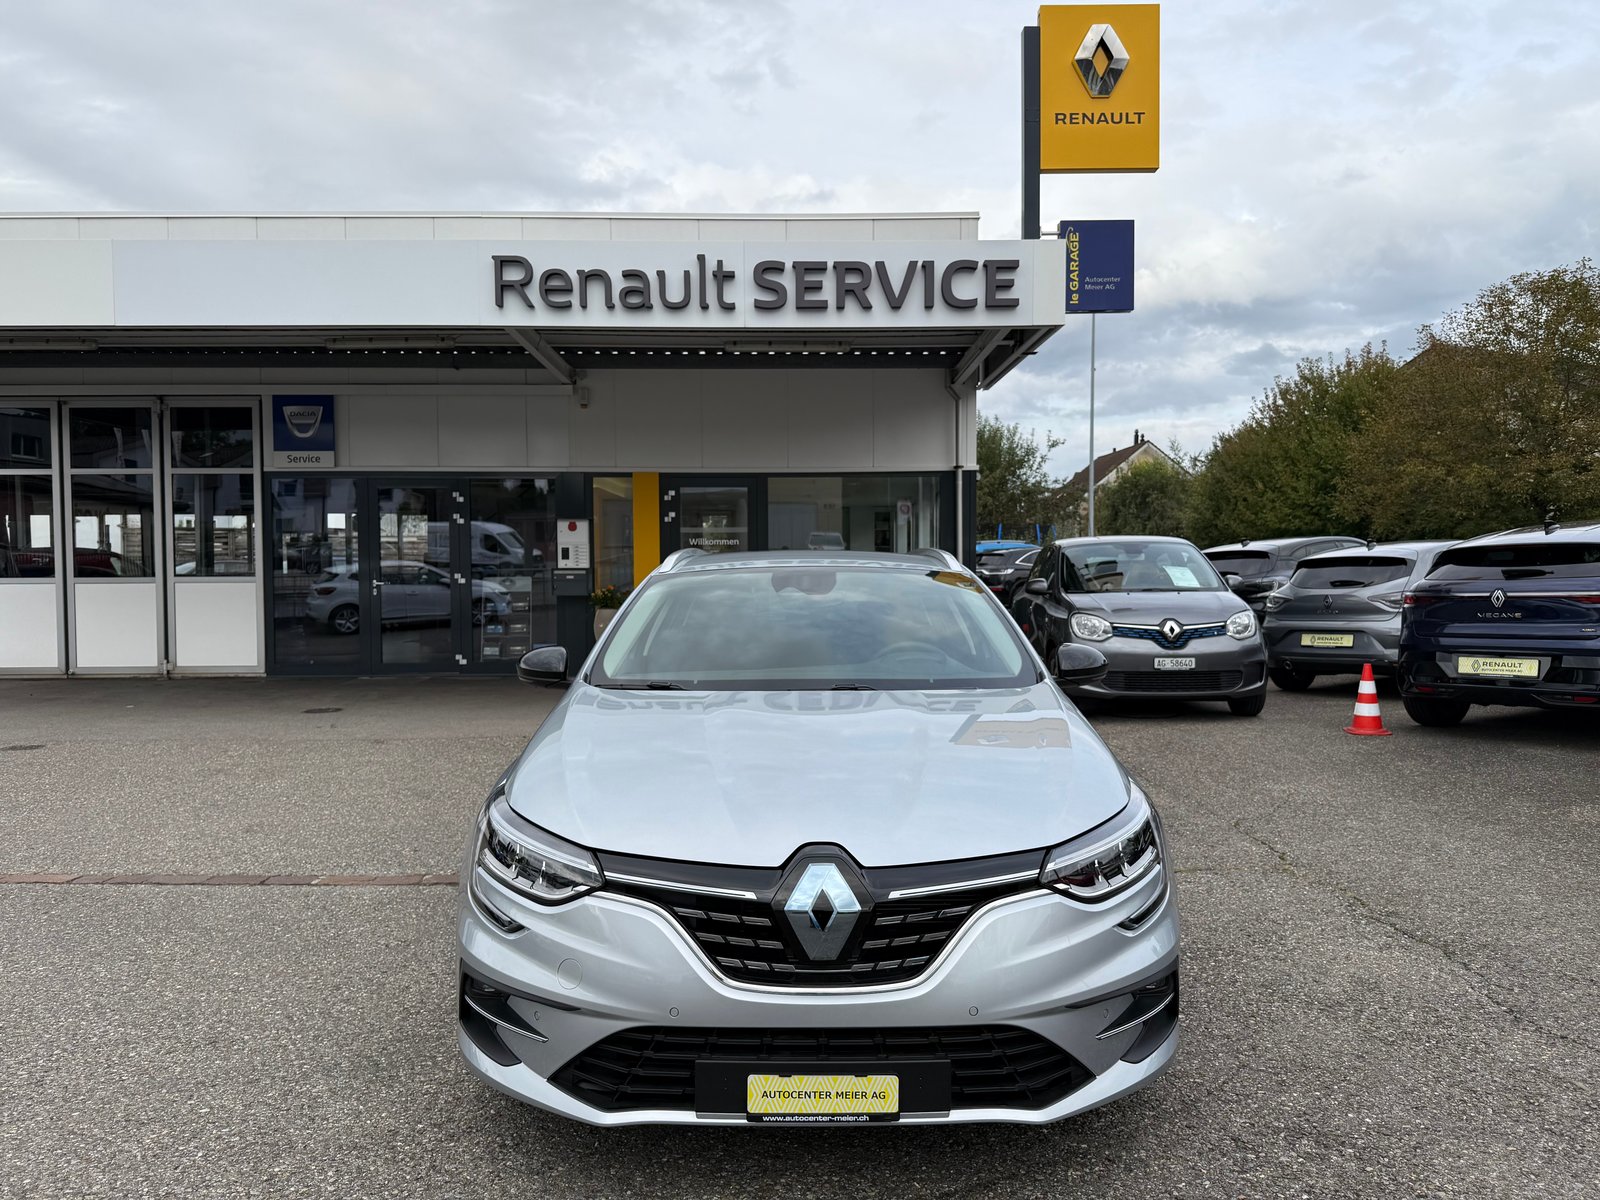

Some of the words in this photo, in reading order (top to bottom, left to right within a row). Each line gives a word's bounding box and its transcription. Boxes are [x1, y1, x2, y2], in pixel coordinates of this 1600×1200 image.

[1055, 112, 1145, 124] RENAULT
[1069, 232, 1079, 291] GARAGE
[491, 253, 736, 310] Renault
[753, 259, 1020, 310] SERVICE
[1070, 293, 1079, 304] le
[286, 454, 321, 464] Service
[689, 537, 740, 546] Willkommen
[1482, 661, 1523, 669] RENAULT
[761, 1090, 832, 1100] AUTOCENTER
[835, 1091, 868, 1100] MEIER
[871, 1091, 886, 1100] AG
